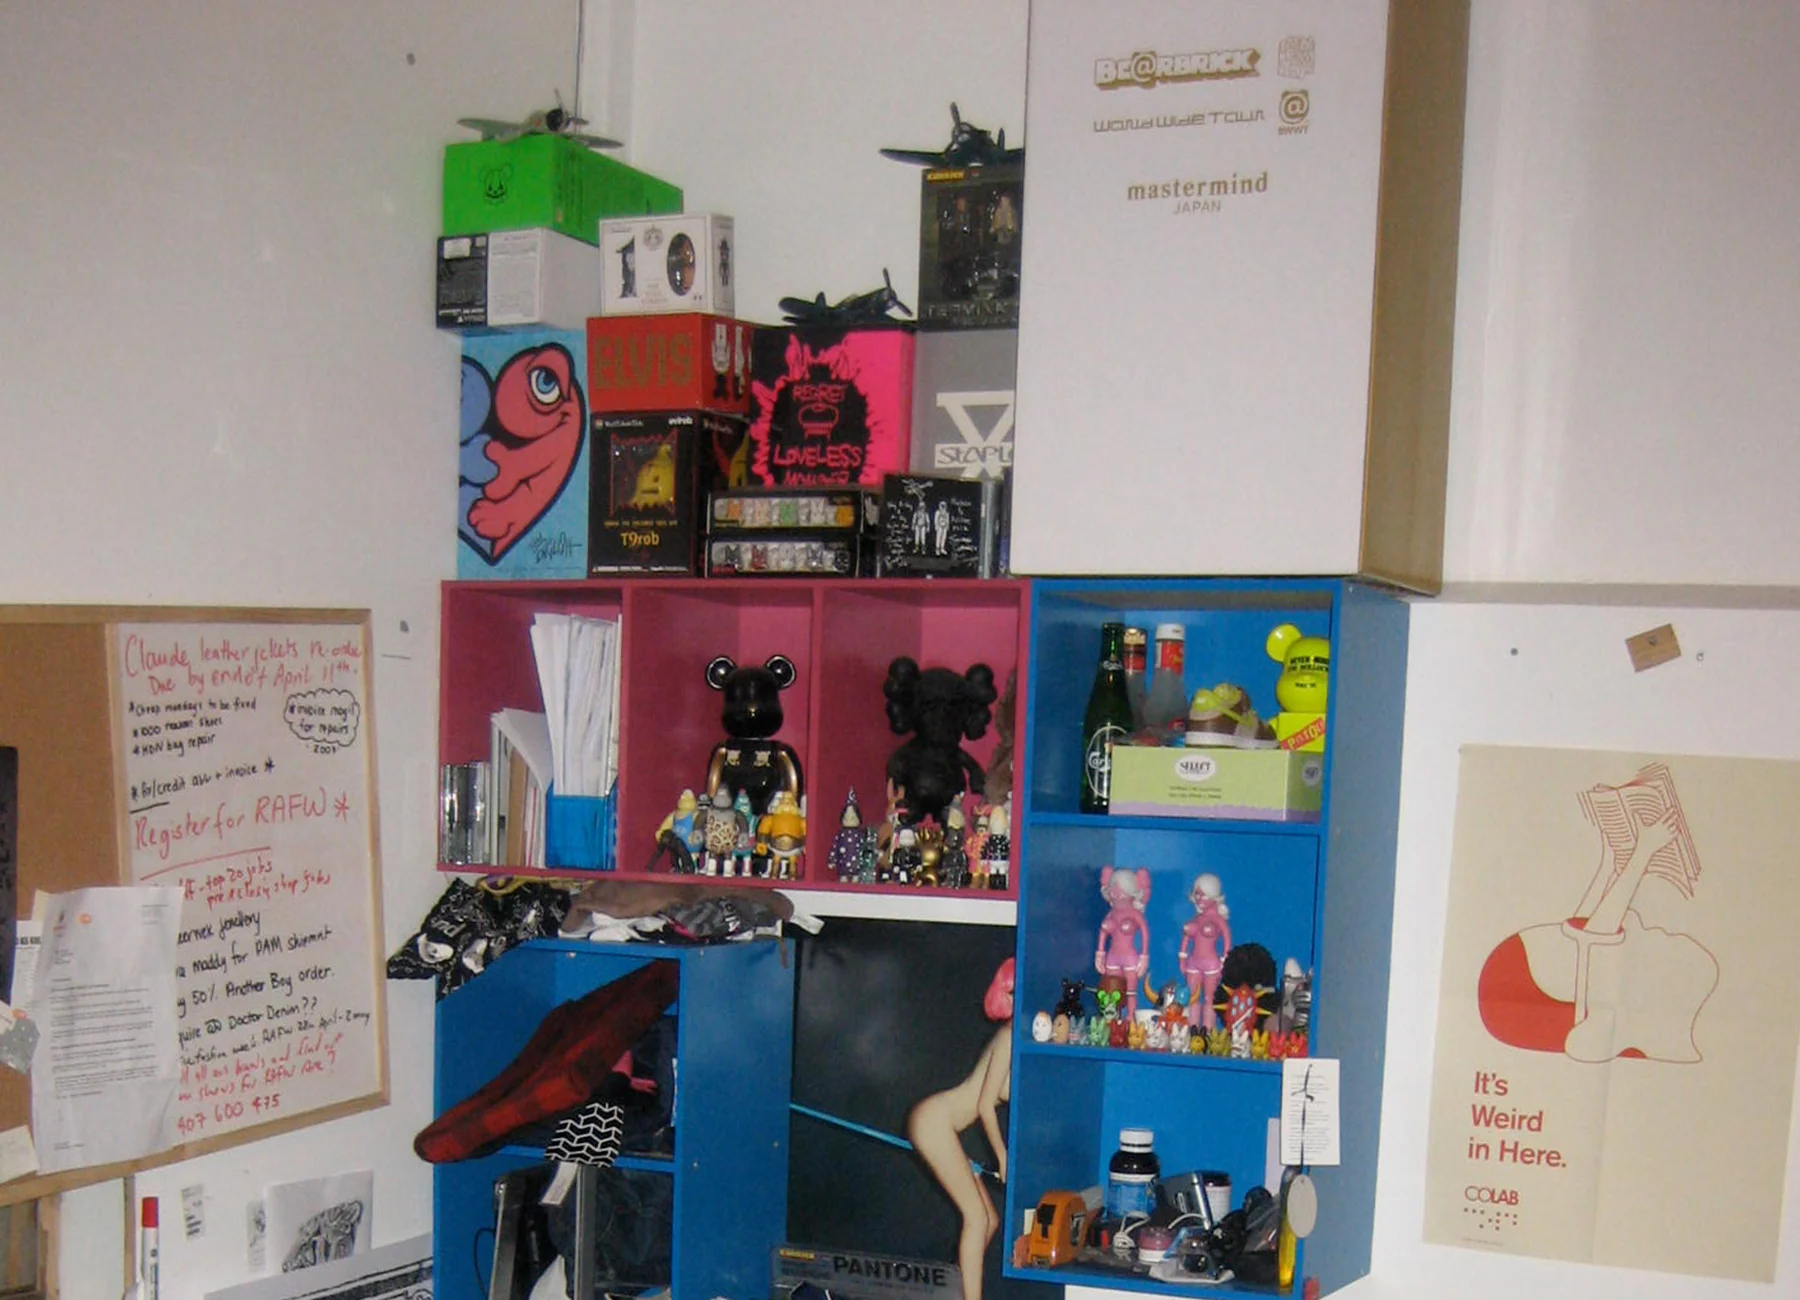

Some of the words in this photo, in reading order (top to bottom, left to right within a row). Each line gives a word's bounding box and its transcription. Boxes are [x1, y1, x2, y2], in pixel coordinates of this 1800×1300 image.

[1127, 171, 1269, 201] mastermind
[1173, 200, 1222, 215] JAPAN
[594, 332, 693, 390] ELVIS
[773, 443, 863, 468] LOVELESS
[620, 531, 660, 547] T9rob
[125, 634, 190, 678] Claude
[200, 637, 249, 661] leather
[148, 675, 176, 697] Due
[187, 660, 205, 696] by
[212, 664, 243, 687] end
[244, 666, 267, 689] of
[273, 663, 312, 693] April
[136, 812, 211, 860] Register
[215, 803, 245, 840] for
[255, 786, 328, 824] RAFW
[231, 942, 249, 966] for
[226, 979, 265, 997] Another
[270, 971, 294, 997] Boy
[228, 1012, 264, 1030] Doctor
[1474, 1071, 1509, 1096] It's
[1472, 1104, 1543, 1132] Weird
[1468, 1136, 1490, 1160] in
[1499, 1139, 1567, 1168] Here.
[1464, 1185, 1520, 1206] COLAB
[834, 1256, 949, 1288] PANTONE
